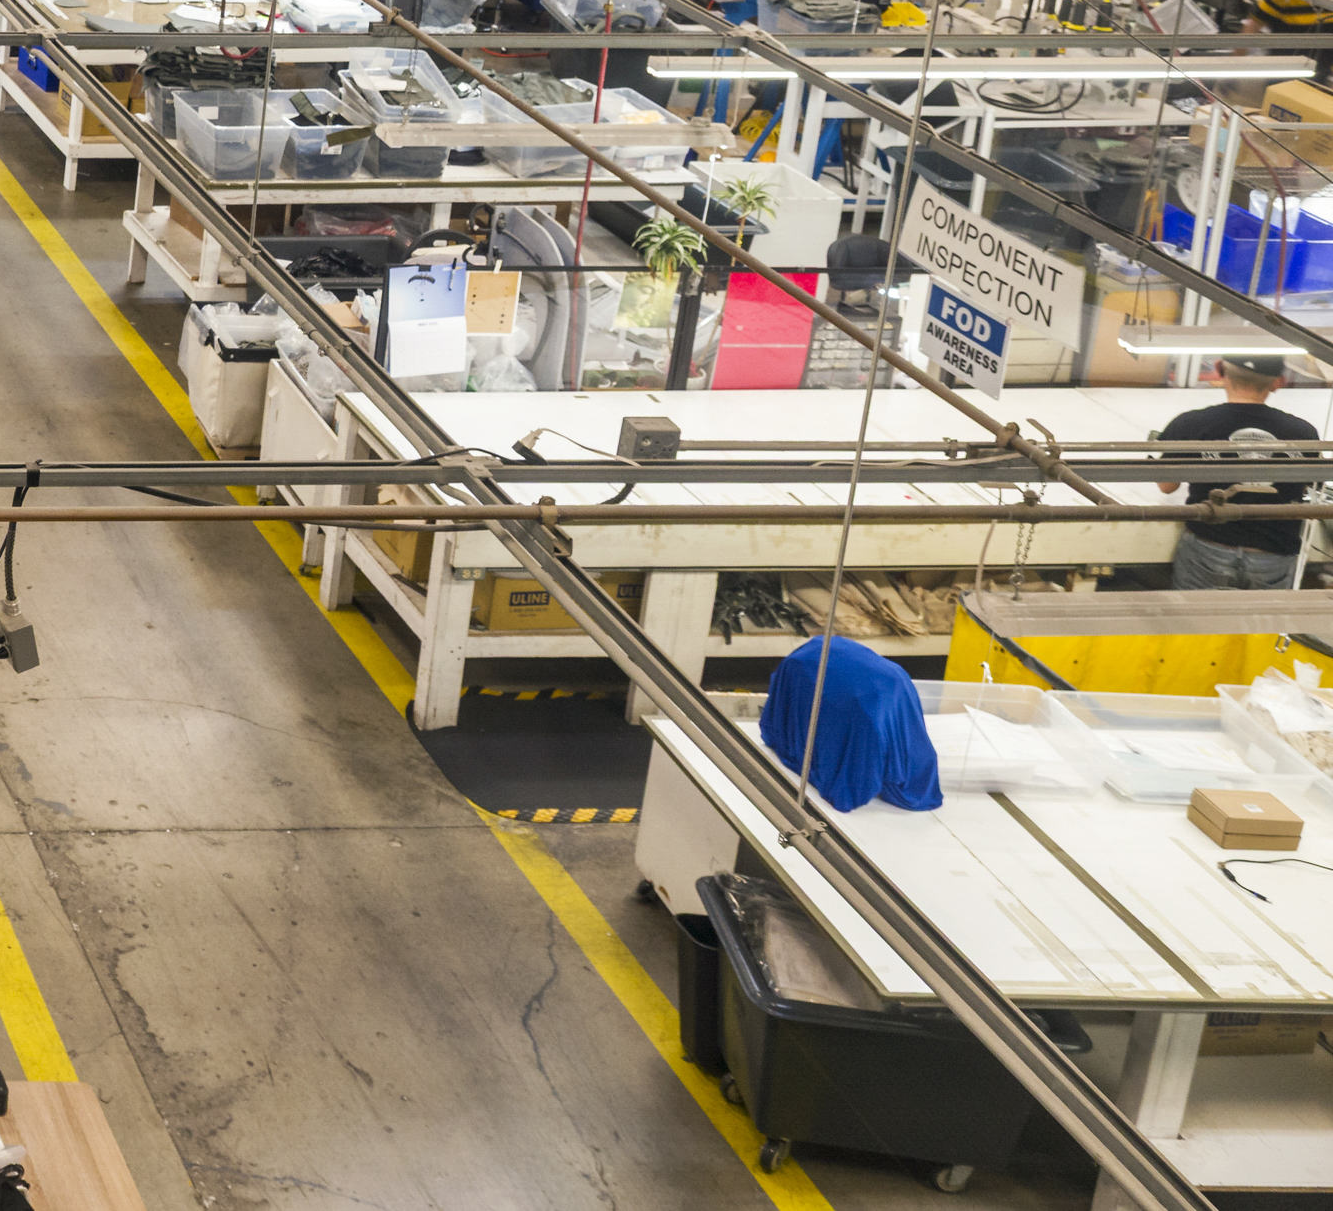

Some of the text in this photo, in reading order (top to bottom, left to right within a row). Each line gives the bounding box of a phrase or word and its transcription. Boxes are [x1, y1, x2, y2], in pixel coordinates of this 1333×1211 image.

[921, 197, 1063, 292] COMPONENT
[916, 232, 1053, 328] INSPECTION
[940, 296, 992, 343] FOD
[925, 321, 999, 375] AWARENESS
[943, 349, 974, 378] AREA
[511, 592, 548, 605] ULINE
